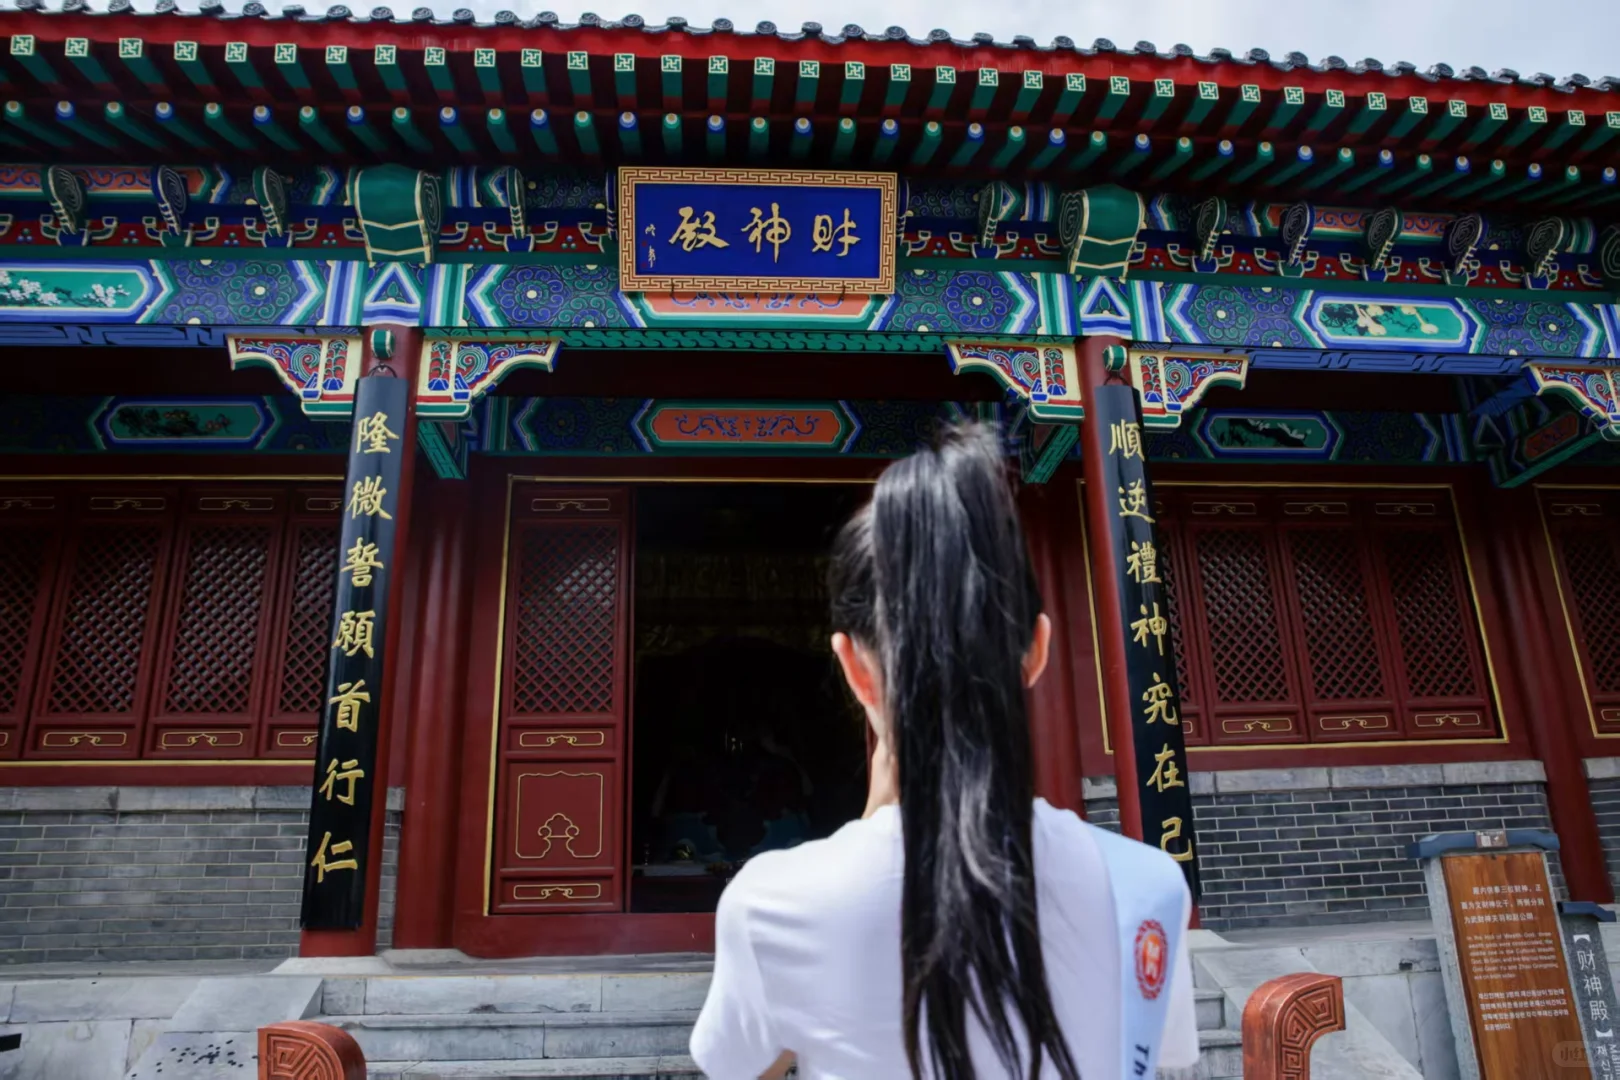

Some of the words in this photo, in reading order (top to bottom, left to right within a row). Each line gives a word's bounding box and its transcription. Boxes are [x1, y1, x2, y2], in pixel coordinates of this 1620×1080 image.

[1108, 418, 1194, 862] 順逆禮神究在己
